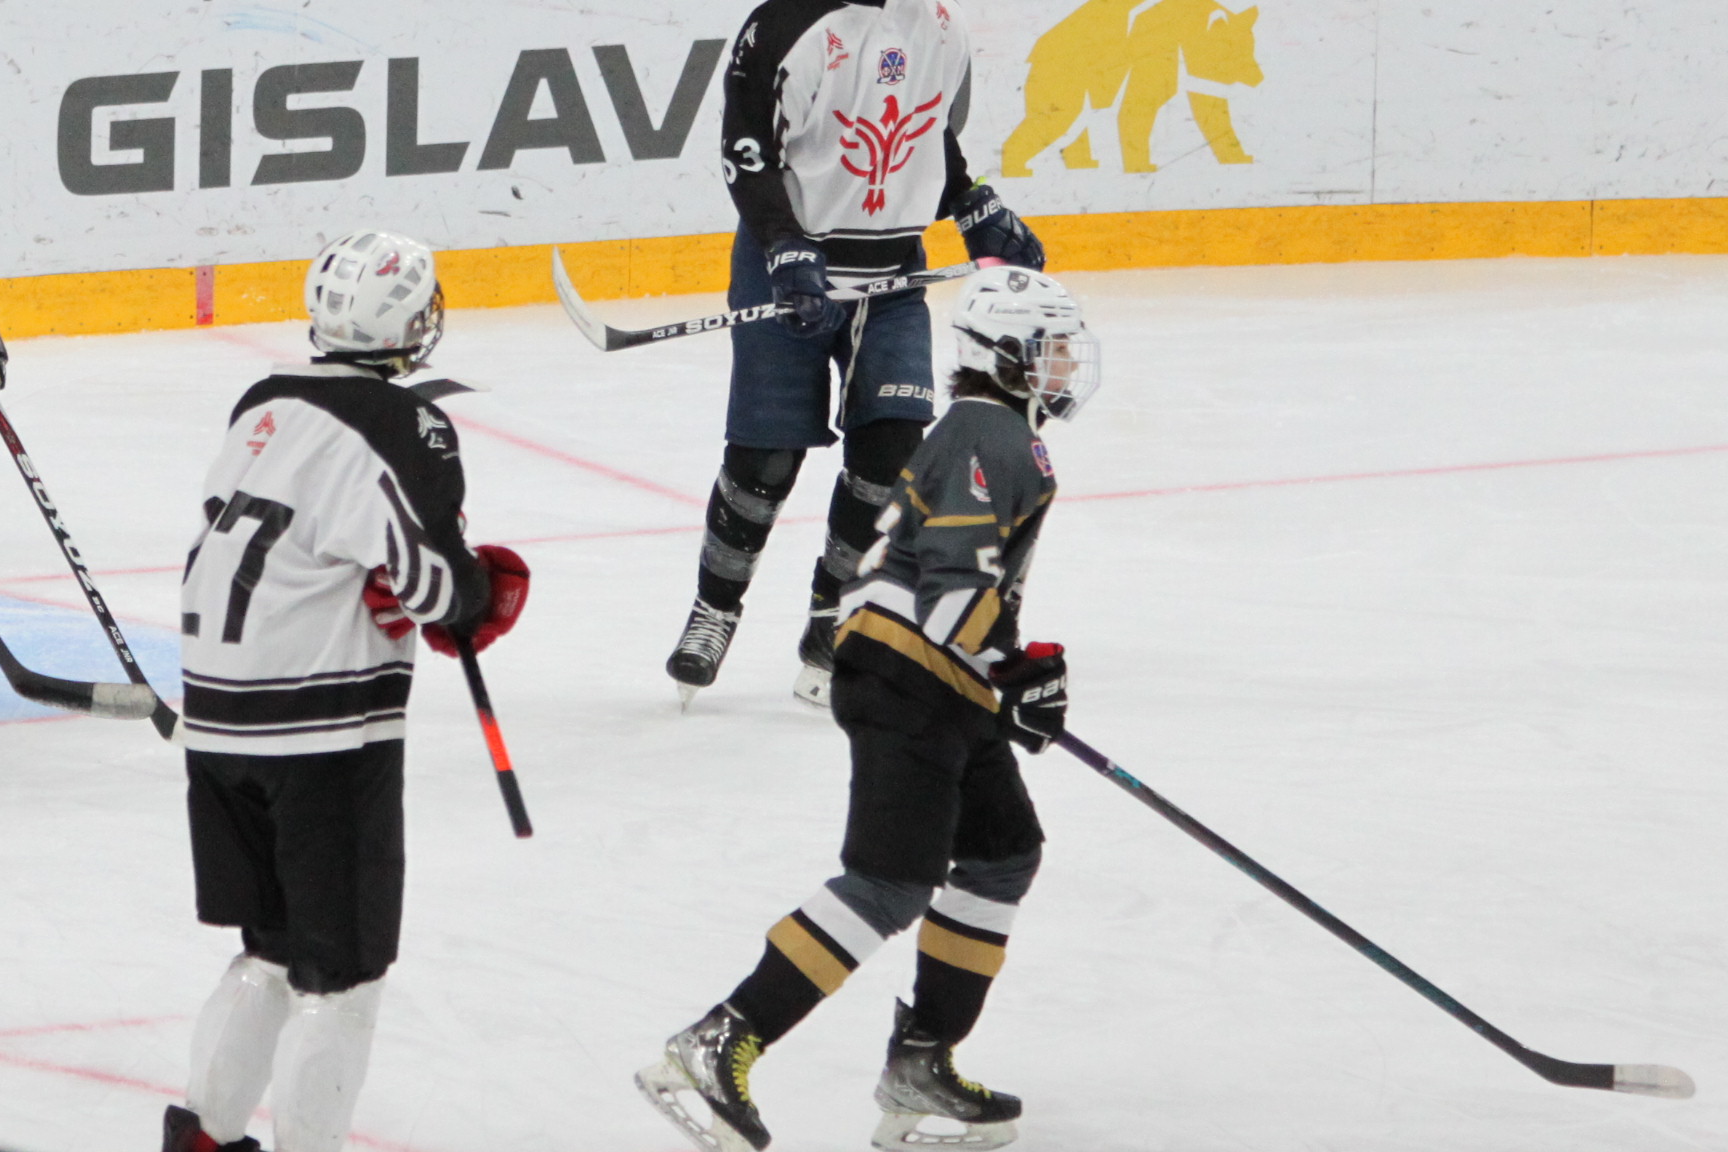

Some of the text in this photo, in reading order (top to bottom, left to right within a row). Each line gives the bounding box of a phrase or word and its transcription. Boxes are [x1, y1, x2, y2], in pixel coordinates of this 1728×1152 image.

[57, 38, 970, 195] GISLAV
[957, 195, 1005, 234] AUER
[767, 249, 817, 276] UER
[868, 276, 908, 295] ACE JNR
[685, 303, 777, 335] SOYUZ
[878, 384, 935, 402] BAUE
[16, 452, 98, 592] SOYUZ
[108, 625, 134, 663] ACE JNR
[1022, 675, 1068, 704] BAU
